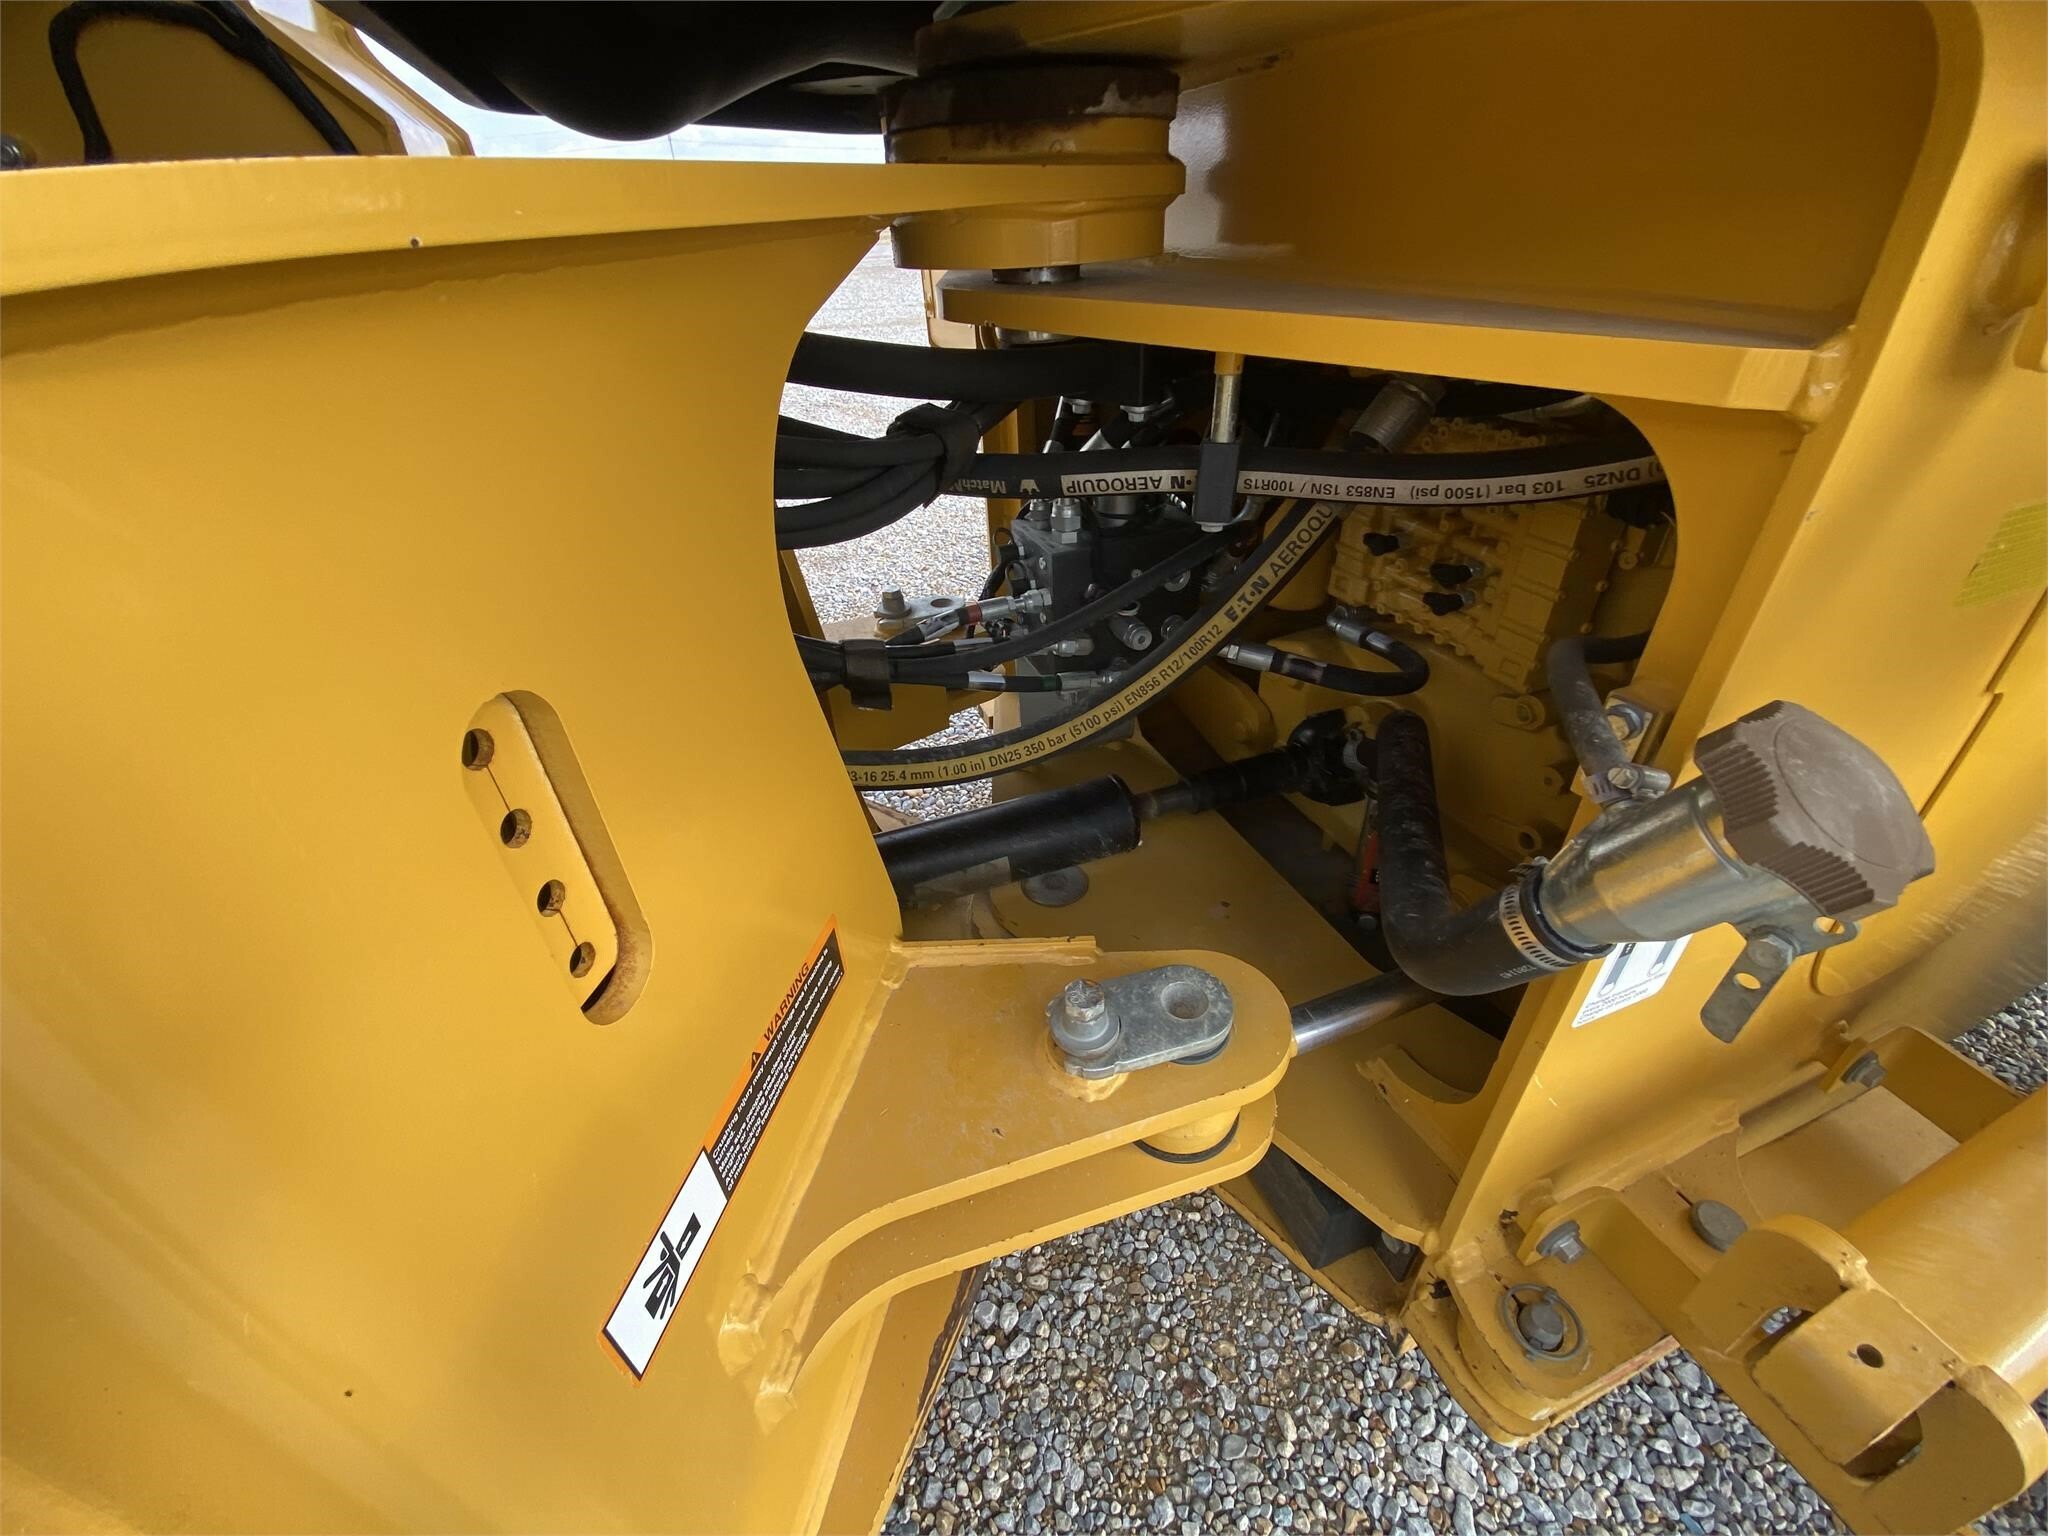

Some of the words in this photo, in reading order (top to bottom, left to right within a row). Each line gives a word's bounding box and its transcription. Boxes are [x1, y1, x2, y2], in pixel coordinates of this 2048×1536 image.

[1066, 476, 1163, 494] AEROQUIP
[1242, 478, 1294, 493] 100R1S
[1532, 480, 1564, 495] 103
[1583, 467, 1640, 489] DN25
[1310, 483, 1340, 496] 1SN
[1346, 485, 1396, 499] EN853
[1410, 484, 1440, 500] psi)
[1445, 484, 1490, 500] (1500
[1496, 484, 1526, 499] bar
[881, 769, 907, 782] 25.4
[910, 770, 935, 781] mm
[938, 762, 967, 779] (1.00
[970, 758, 986, 773] in)
[989, 747, 1022, 768] DN25
[1024, 740, 1046, 757] 350
[1048, 732, 1067, 748] bar
[1069, 715, 1101, 739] (5100
[1102, 700, 1126, 722] psi)
[1125, 676, 1161, 706] EN856
[1161, 624, 1224, 682] R12/100R12
[764, 962, 809, 1042] WARNING
[711, 1112, 738, 1159] Crushing
[737, 1085, 753, 1112] injury
[752, 1065, 764, 1086] may
[763, 1039, 777, 1064] result
[781, 1007, 795, 1031] hinge
[806, 954, 824, 985] machine
[718, 1144, 734, 1171] Make
[733, 1121, 746, 1143] sure
[745, 1089, 763, 1121] people
[714, 1128, 735, 1164] turned.
[720, 1143, 741, 1178] engine
[724, 1151, 742, 1184] Attach
